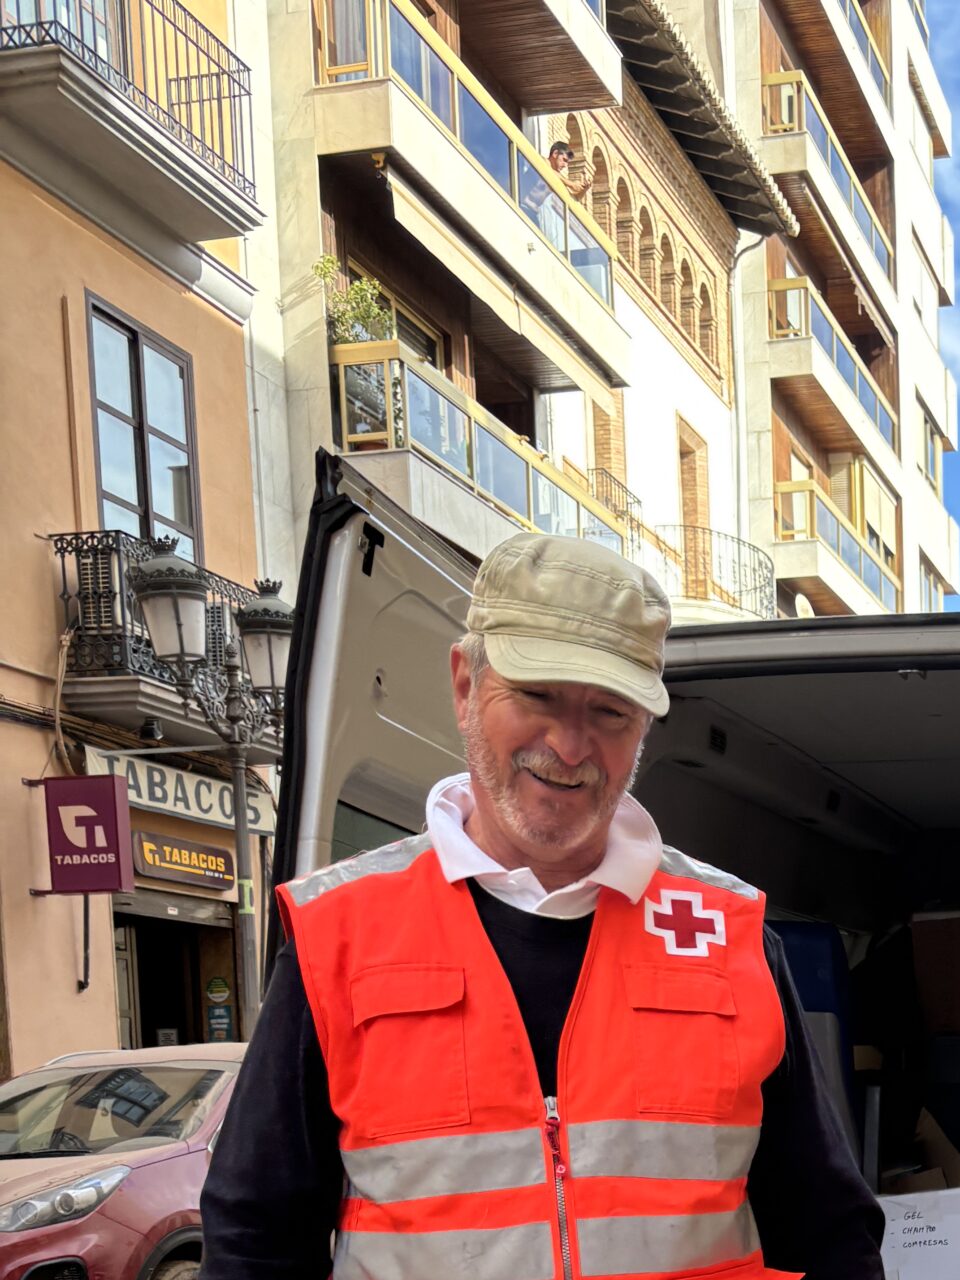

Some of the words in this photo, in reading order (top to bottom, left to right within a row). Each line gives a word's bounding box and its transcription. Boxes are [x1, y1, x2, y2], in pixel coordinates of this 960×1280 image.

[54, 852, 116, 865] TABACOS
[163, 845, 226, 872] TABACOS
[904, 1211, 924, 1221] GEL
[902, 1239, 949, 1249] COMPRESAS
